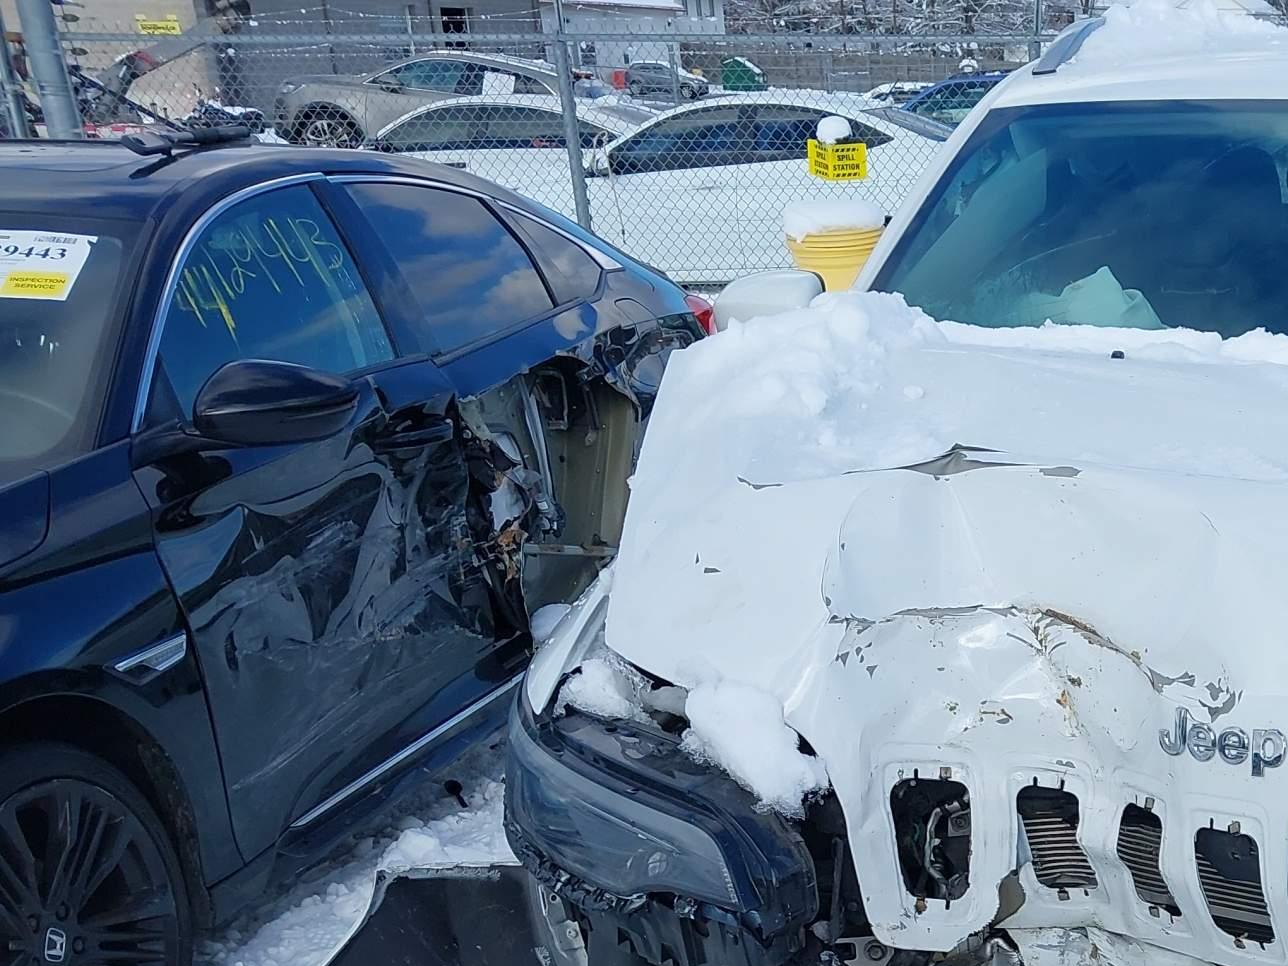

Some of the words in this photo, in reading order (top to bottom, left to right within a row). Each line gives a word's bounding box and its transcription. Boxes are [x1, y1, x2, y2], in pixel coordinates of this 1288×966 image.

[0, 244, 68, 260] 9443
[9, 276, 67, 285] INSPECTION
[14, 282, 57, 290] SERVICE
[1158, 706, 1288, 778] Jeep
